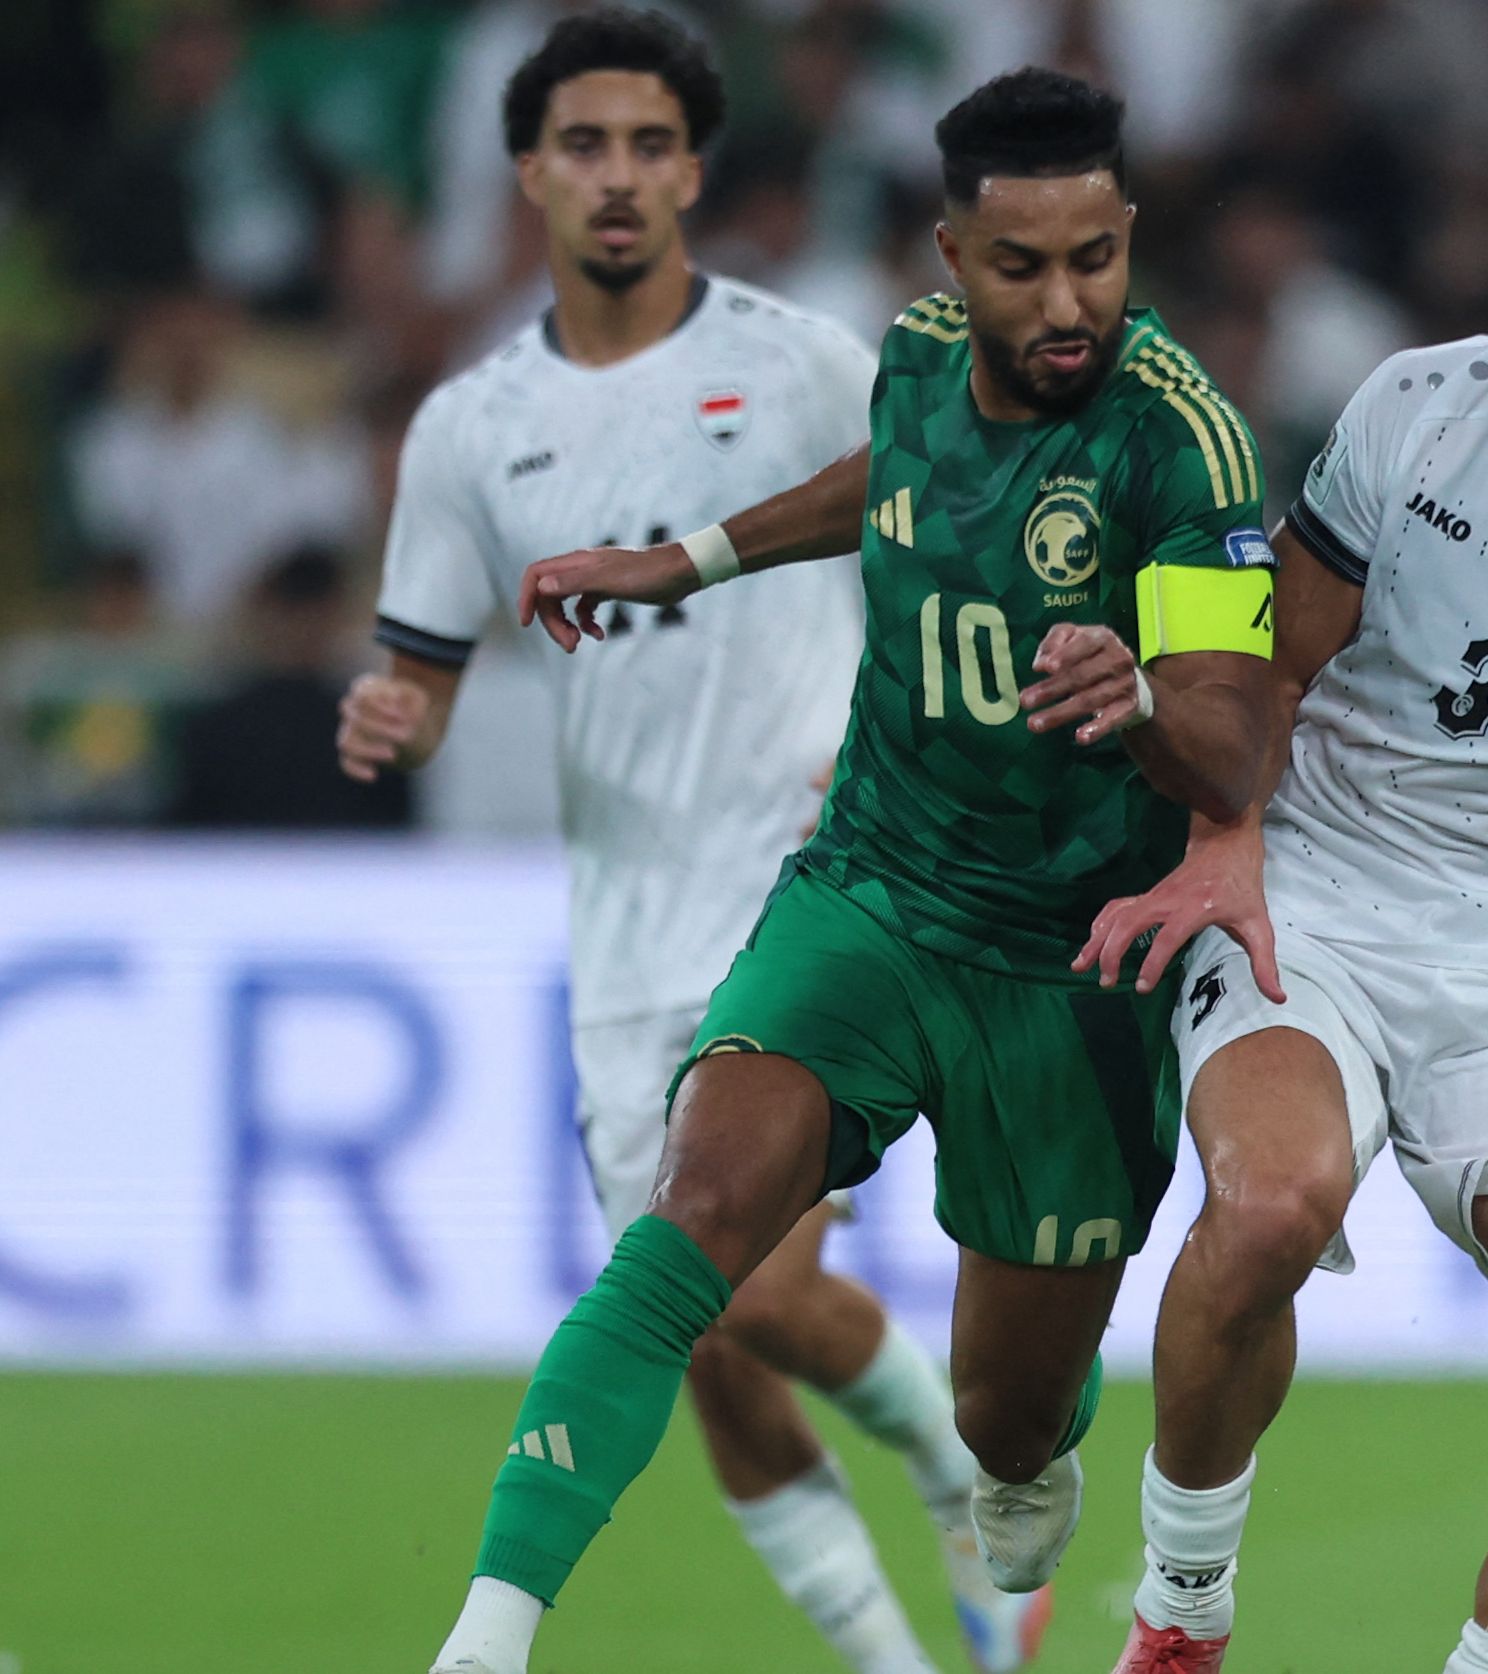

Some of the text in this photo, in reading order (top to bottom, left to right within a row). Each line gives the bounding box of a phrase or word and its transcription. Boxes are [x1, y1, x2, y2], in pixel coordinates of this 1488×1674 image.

[1405, 492, 1472, 542] JAKO
[1043, 592, 1090, 608] SAUDI
[921, 593, 1020, 726] 10
